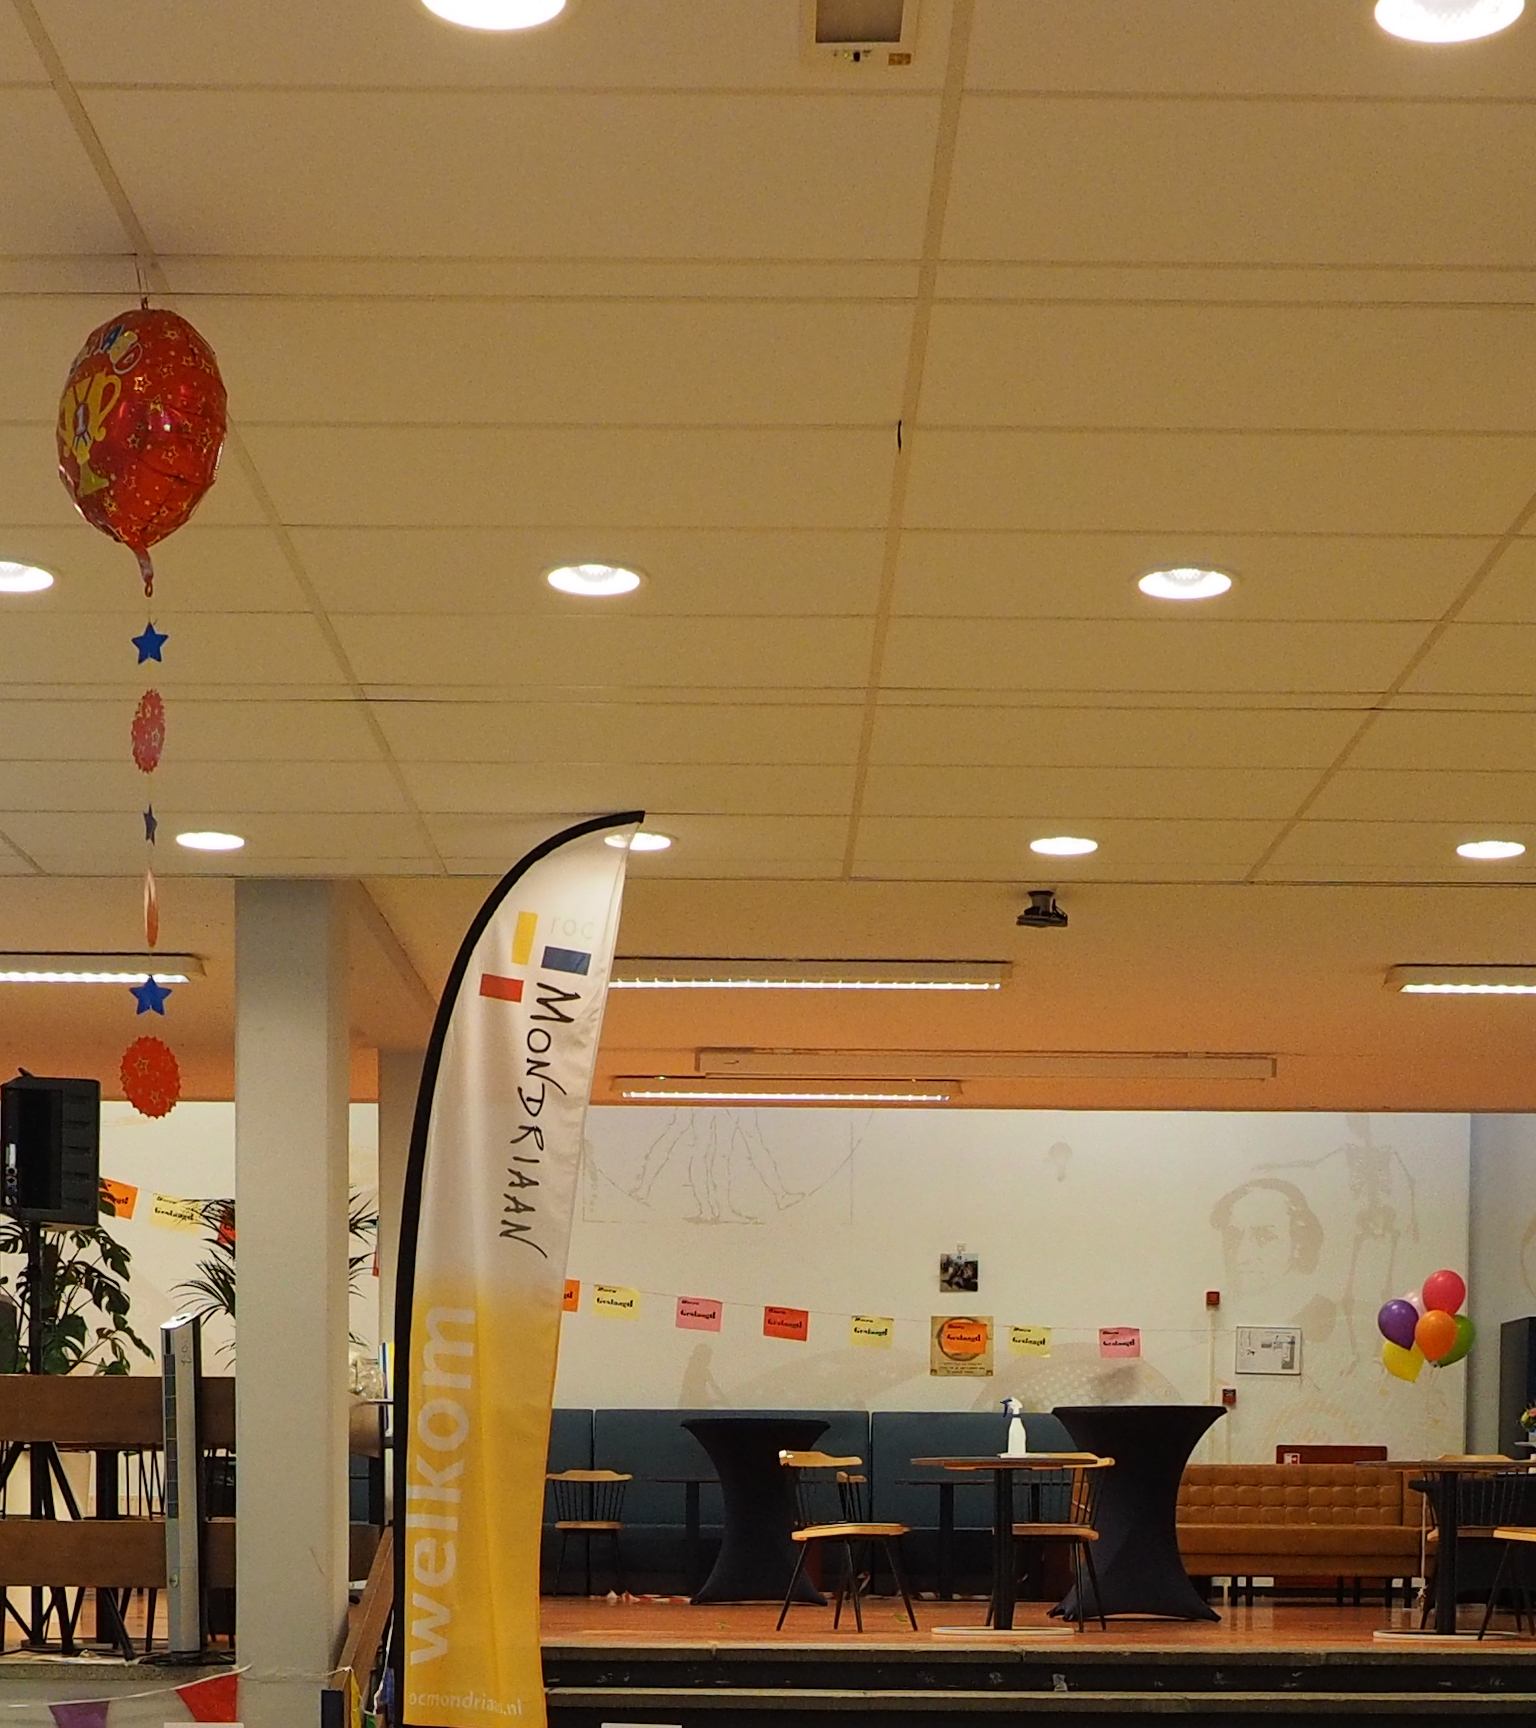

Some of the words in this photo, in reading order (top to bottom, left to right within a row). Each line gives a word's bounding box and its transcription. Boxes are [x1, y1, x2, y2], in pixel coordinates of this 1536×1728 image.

[550, 917, 595, 939] roc
[499, 982, 582, 1259] MONDRIAAN
[406, 1307, 476, 1665] welkom
